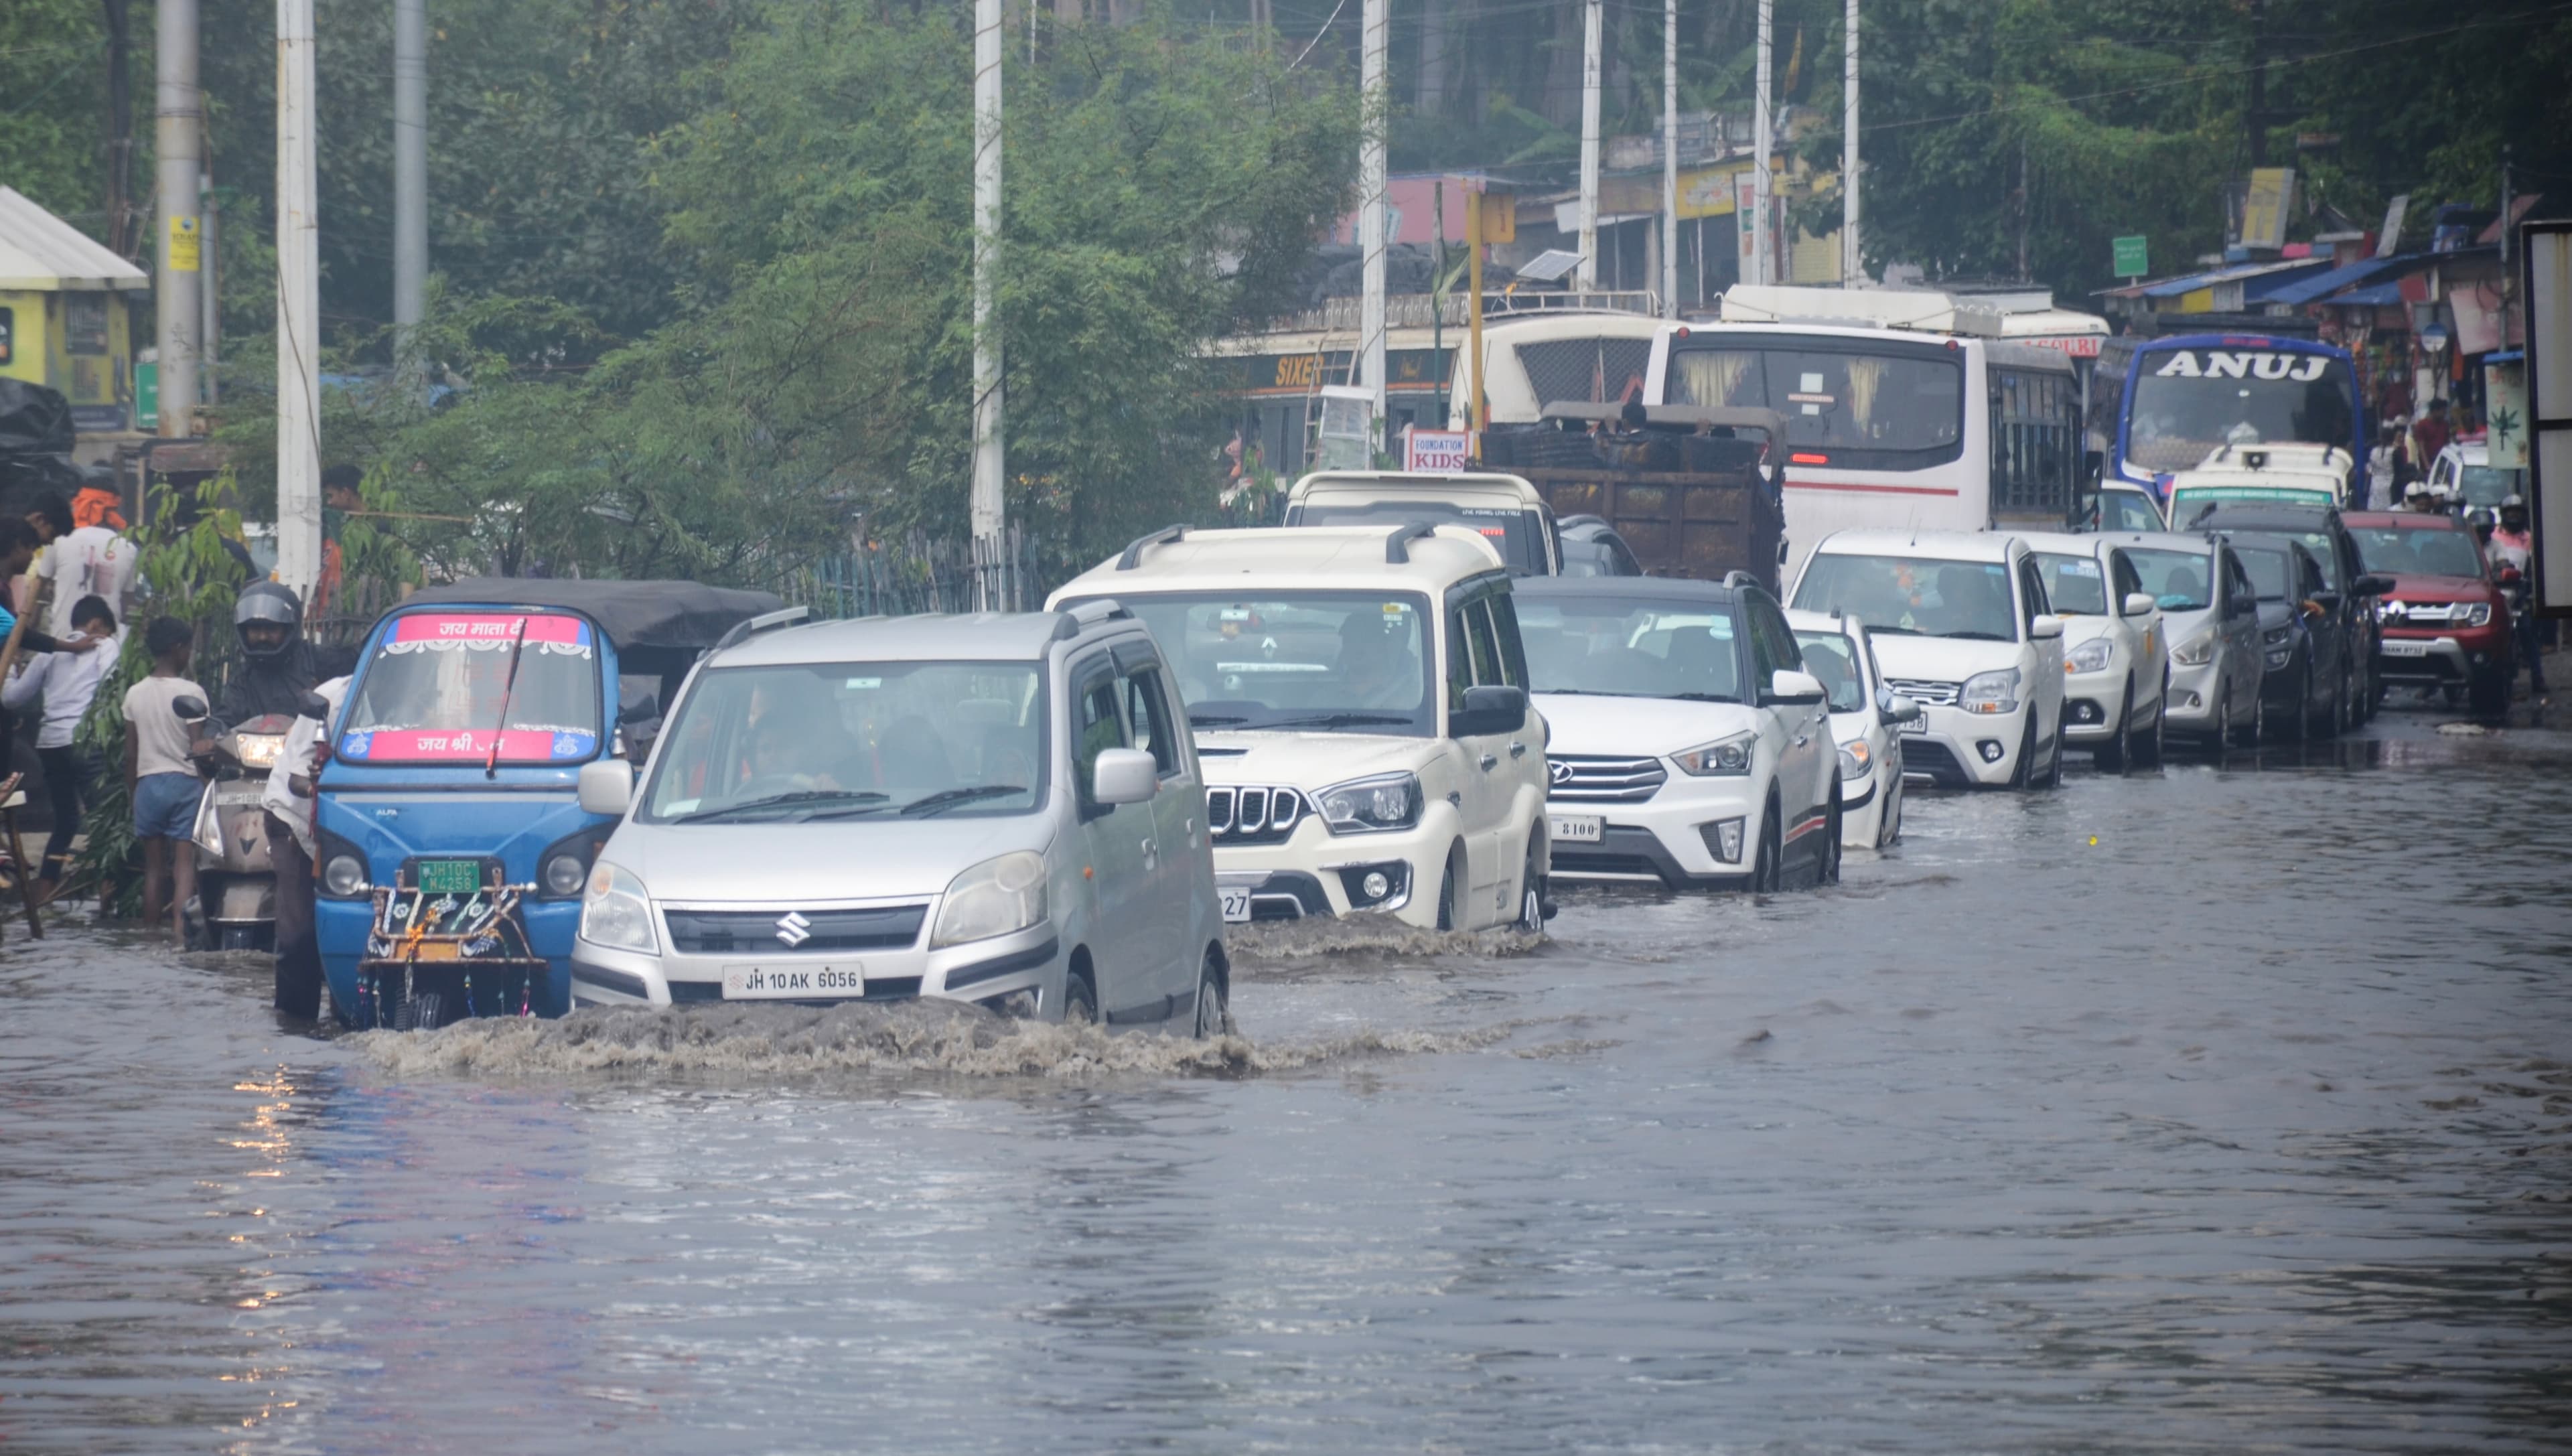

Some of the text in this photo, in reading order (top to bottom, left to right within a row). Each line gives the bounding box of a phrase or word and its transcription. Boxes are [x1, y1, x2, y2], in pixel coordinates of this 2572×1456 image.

[1275, 355, 1324, 386] SIXER
[2155, 350, 2330, 381] ANUJ
[1415, 439, 1462, 451] FOUNDATION
[1415, 453, 1464, 469] KIDS
[439, 623, 468, 635] जय
[471, 623, 506, 635] माता
[417, 738, 447, 751] जय
[451, 733, 473, 751] श्री
[1563, 823, 1594, 835] 8100
[430, 864, 472, 877] JH10C
[1219, 896, 1246, 916] 27
[746, 974, 764, 989] JH
[818, 972, 857, 988] 6056
